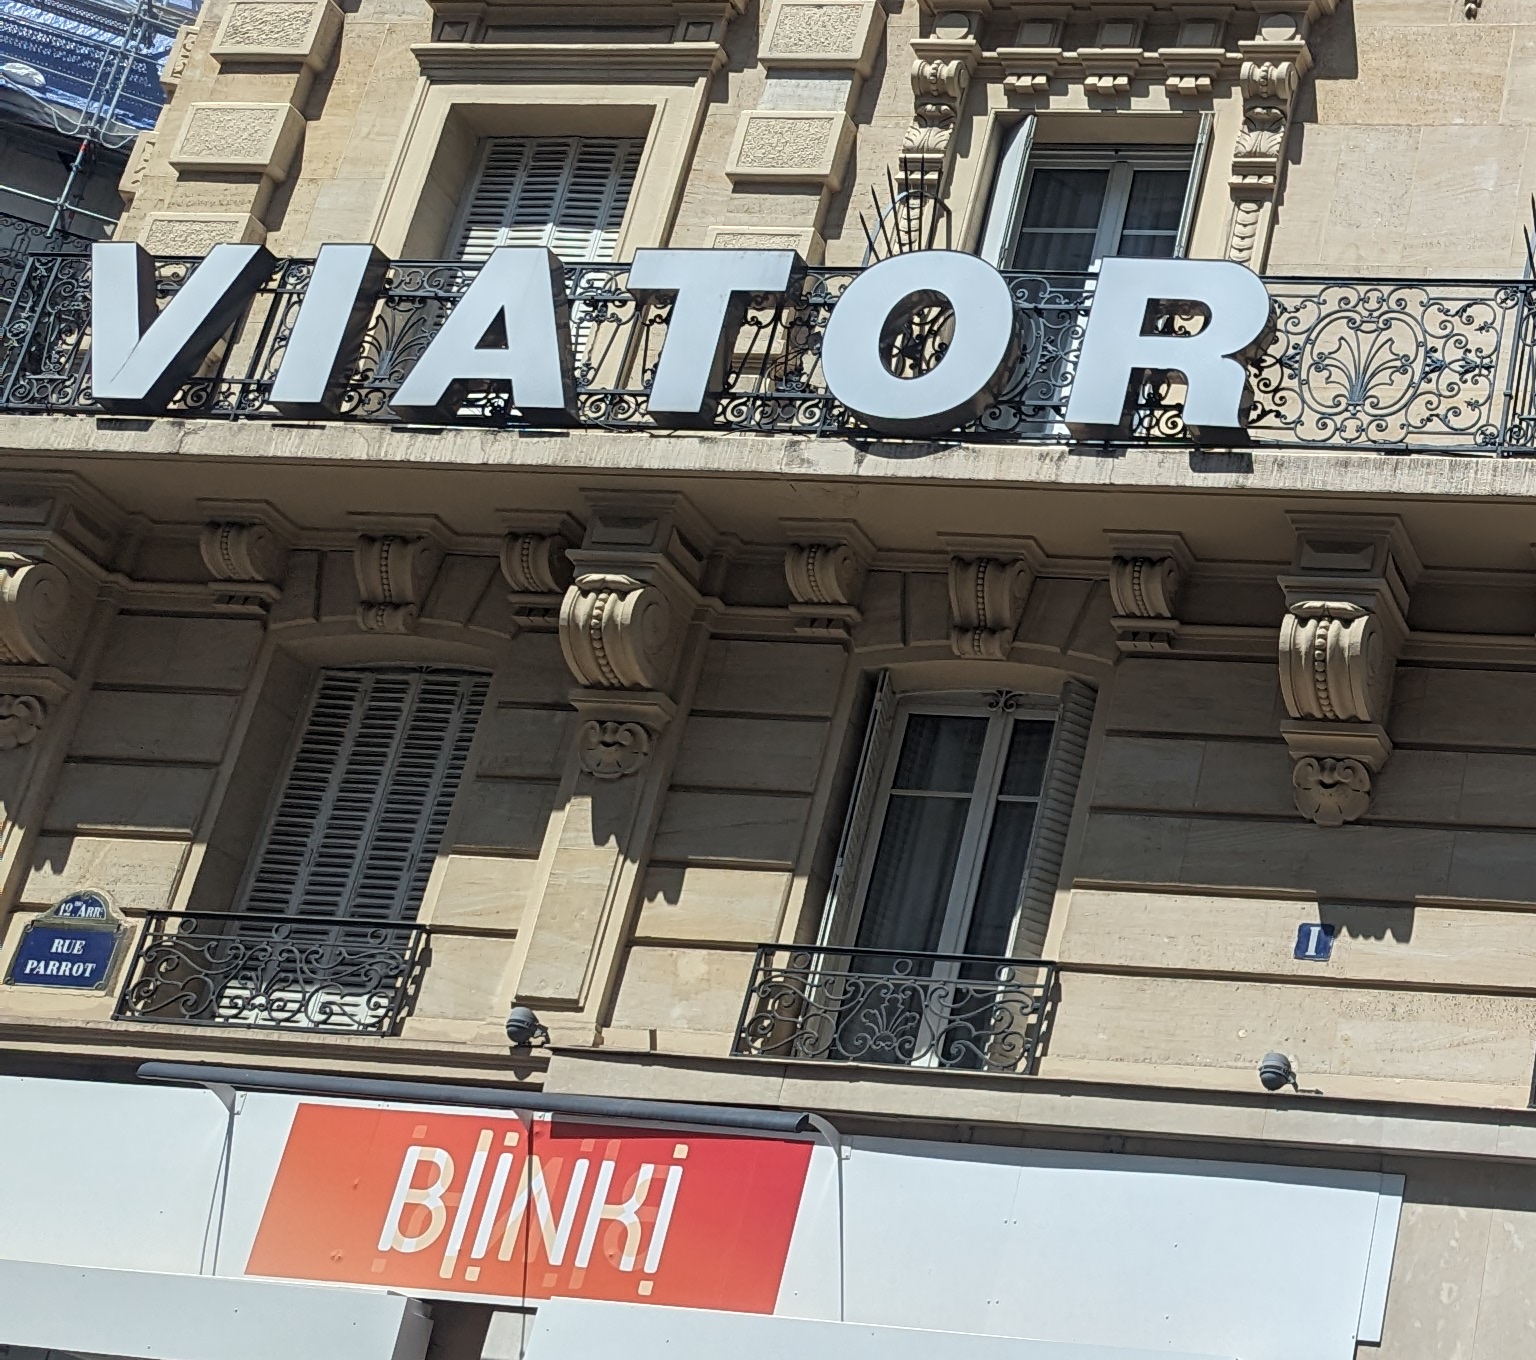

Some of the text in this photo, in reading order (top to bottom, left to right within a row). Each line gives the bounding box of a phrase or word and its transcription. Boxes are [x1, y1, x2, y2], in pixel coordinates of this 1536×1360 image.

[92, 242, 1277, 434] VIATOR
[50, 938, 86, 955] RUE
[24, 959, 97, 978] PARROT
